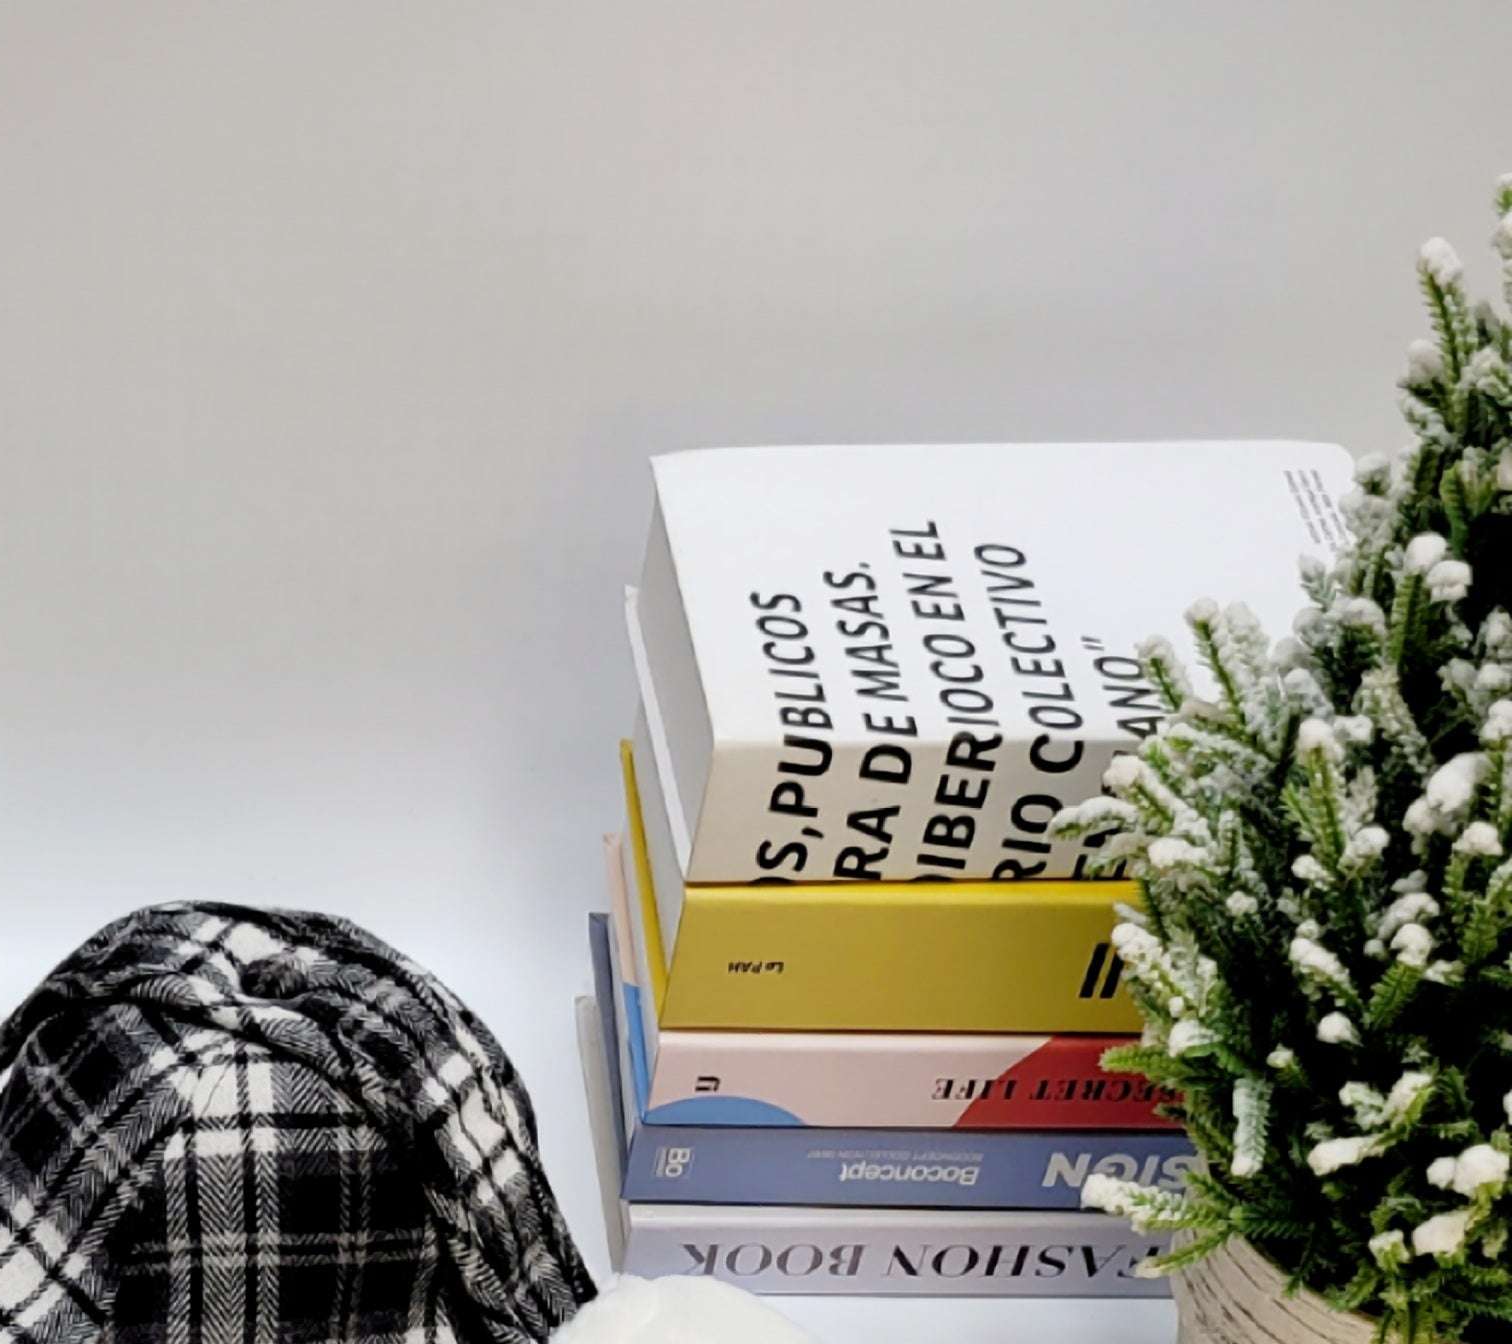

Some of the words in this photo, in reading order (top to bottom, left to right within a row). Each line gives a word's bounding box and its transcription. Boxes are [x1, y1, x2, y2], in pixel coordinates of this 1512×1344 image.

[888, 520, 947, 561] EL
[902, 572, 965, 621] EN
[823, 561, 909, 702] MASAS.
[973, 543, 1085, 774] COLECTIVO
[859, 712, 918, 784] DE
[909, 633, 1003, 882] IBERIOCO
[931, 1078, 1020, 1101] LIFE
[838, 1159, 981, 1186] Boconcept
[682, 1243, 867, 1276] BOOK
